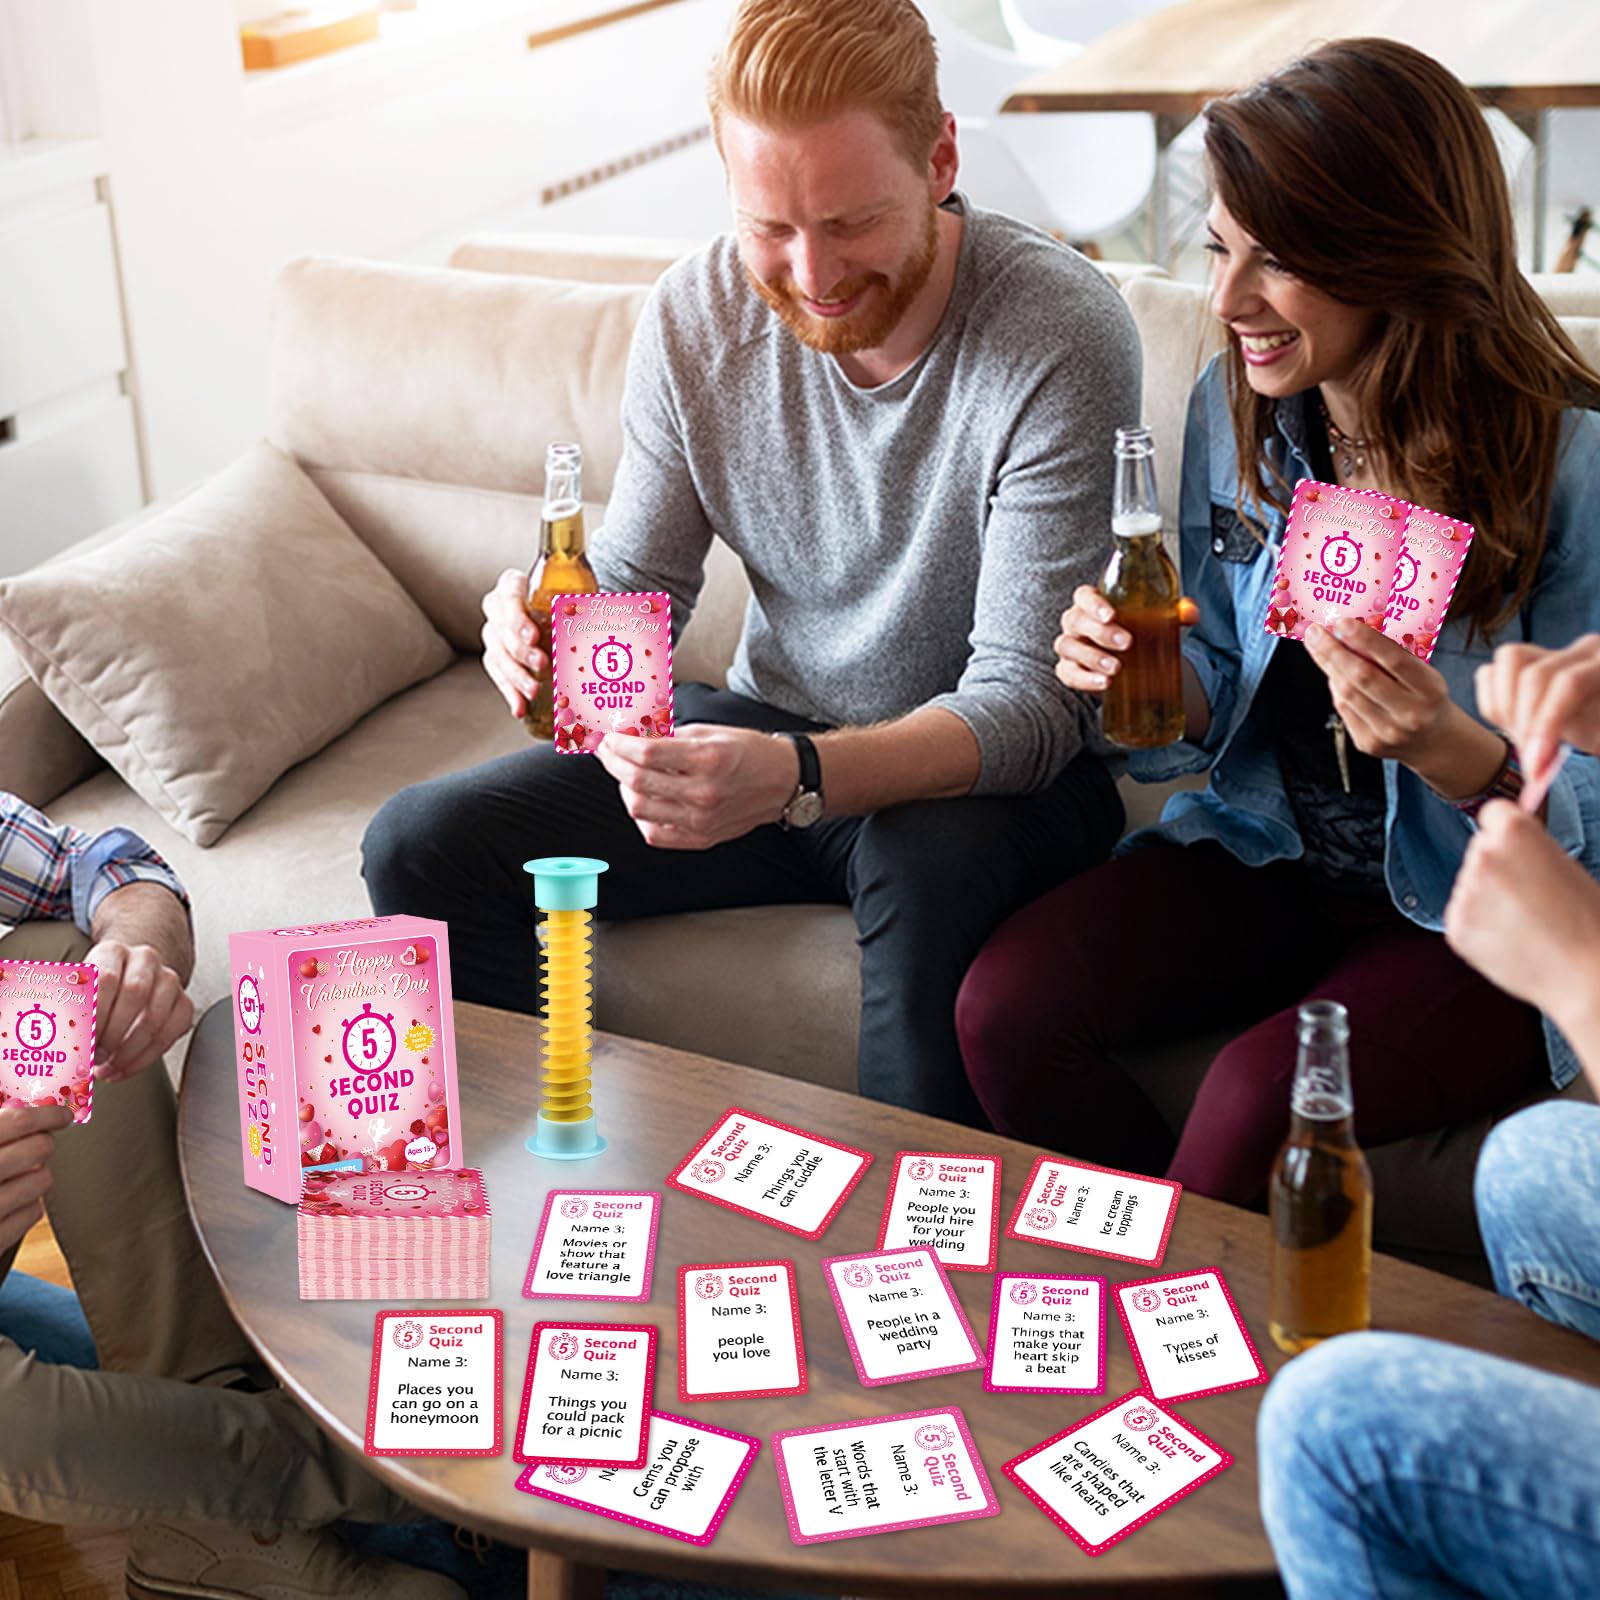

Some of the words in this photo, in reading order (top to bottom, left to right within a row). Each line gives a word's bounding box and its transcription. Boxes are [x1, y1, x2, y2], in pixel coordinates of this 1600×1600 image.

[1330, 492, 1375, 515] Happy
[1367, 519, 1395, 539] Day
[1335, 547, 1347, 567] 5
[1303, 570, 1366, 593] SECOND
[1313, 587, 1352, 605] QUIZ
[589, 600, 634, 616] Happy
[630, 618, 661, 634] Day
[608, 652, 618, 672] 5
[581, 681, 645, 694] SECOND
[594, 696, 632, 710] QUIZ
[334, 950, 395, 976] Happy
[16, 966, 62, 984] Happy
[392, 973, 429, 999] Day
[57, 988, 86, 1005] Day
[31, 1020, 41, 1040] 5
[363, 1028, 377, 1059] 5
[3, 1048, 66, 1063] SECOND
[15, 1064, 53, 1077] QUIZ
[243, 1042, 258, 1120] QUIZ
[330, 1069, 413, 1098] SECOND
[256, 1043, 271, 1166] SECOND
[348, 1093, 399, 1119] QUIZ
[711, 1122, 746, 1158] Second
[408, 1147, 422, 1156] Ages
[724, 1139, 749, 1162] Quiz
[734, 1154, 763, 1183] Name
[758, 1143, 773, 1154] 3:
[939, 1164, 984, 1173] Second
[762, 1168, 795, 1201] Things
[791, 1149, 809, 1168] you
[780, 1189, 798, 1207] can
[794, 1156, 822, 1188] cuddle
[939, 1173, 967, 1182] Quiz
[919, 1187, 955, 1197] Name
[960, 1189, 970, 1198] 3:
[1037, 1170, 1059, 1204] Second
[1051, 1184, 1067, 1207] Quiz
[594, 1202, 642, 1210] Second
[908, 1202, 948, 1213] People
[953, 1206, 975, 1215] you
[1067, 1197, 1086, 1224] Name
[1078, 1186, 1090, 1195] 3:
[1100, 1221, 1114, 1235] Ice
[1111, 1190, 1124, 1219] cream
[592, 1211, 623, 1219] Quiz
[907, 1215, 945, 1224] would
[950, 1216, 974, 1226] hire
[1116, 1195, 1138, 1236] toppings
[572, 1225, 609, 1233] Name
[614, 1225, 625, 1234] 3:
[913, 1225, 931, 1235] for
[935, 1228, 965, 1238] your
[563, 1239, 608, 1248] Movies
[909, 1238, 965, 1251] wedding
[560, 1249, 595, 1258] show
[599, 1249, 625, 1259] that
[561, 1259, 608, 1270] feature
[875, 1259, 923, 1272] Second
[546, 1270, 573, 1280] love
[578, 1272, 631, 1284] triangle
[729, 1274, 777, 1284] Second
[880, 1272, 911, 1284] Quiz
[730, 1287, 760, 1297] Quiz
[868, 1290, 908, 1303] Name
[910, 1287, 923, 1297] 3:
[1043, 1286, 1088, 1295] Second
[1163, 1281, 1209, 1296] Second
[1042, 1296, 1071, 1306] Quiz
[1167, 1294, 1198, 1307] Quiz
[712, 1306, 751, 1316] Name
[755, 1304, 767, 1314] 3:
[1024, 1312, 1060, 1321] Name
[1065, 1313, 1075, 1322] 3:
[1156, 1311, 1194, 1326] Name
[1197, 1309, 1209, 1318] 3:
[867, 1315, 912, 1330] People
[915, 1312, 928, 1322] in
[932, 1312, 940, 1320] a
[404, 1331, 412, 1342] 5
[429, 1324, 482, 1334] Second
[879, 1325, 938, 1341] wedding
[1012, 1327, 1054, 1339] Things
[1060, 1330, 1085, 1339] that
[429, 1336, 463, 1348] Quiz
[559, 1343, 568, 1353] 5
[584, 1338, 636, 1349] Second
[718, 1333, 764, 1348] people
[897, 1339, 931, 1354] party
[1014, 1340, 1048, 1349] make
[1052, 1342, 1081, 1351] your
[1163, 1339, 1202, 1354] Types
[1206, 1333, 1219, 1345] of
[408, 1357, 450, 1367] Name
[455, 1357, 467, 1367] 3:
[584, 1351, 616, 1361] Quiz
[713, 1351, 738, 1362] you
[743, 1348, 770, 1358] love
[1014, 1351, 1048, 1360] heart
[1052, 1352, 1079, 1363] skip
[1176, 1349, 1216, 1364] kisses
[560, 1369, 602, 1380] Name
[606, 1370, 619, 1381] 3:
[1038, 1363, 1066, 1373] beat
[398, 1383, 442, 1395] Places
[447, 1386, 473, 1396] you
[392, 1401, 417, 1409] can
[422, 1401, 441, 1411] go
[549, 1396, 596, 1410] Things
[601, 1399, 627, 1411] you
[391, 1412, 478, 1425] honeymoon
[547, 1410, 586, 1422] could
[591, 1411, 625, 1425] pack
[542, 1423, 563, 1435] for
[567, 1427, 575, 1436] a
[580, 1426, 623, 1439] picnic
[1148, 1434, 1177, 1459] Quiz
[1158, 1426, 1206, 1463] Second
[814, 1446, 827, 1466] the
[1112, 1433, 1147, 1464] Name
[1146, 1461, 1161, 1475] 3:
[634, 1462, 662, 1497] Gems
[658, 1439, 678, 1462] you
[833, 1449, 852, 1477] start
[891, 1445, 911, 1481] Name
[904, 1484, 919, 1496] 3:
[650, 1488, 669, 1510] can
[665, 1438, 699, 1487] propose
[682, 1465, 704, 1492] with
[851, 1440, 872, 1480] Words
[862, 1483, 880, 1509] that
[924, 1456, 944, 1486] Quiz
[942, 1453, 972, 1501] Second
[1074, 1440, 1119, 1481] Candies
[1119, 1479, 1145, 1504] that
[819, 1470, 837, 1502] letter
[1063, 1453, 1083, 1471] are
[1082, 1469, 1128, 1509] shaped
[842, 1479, 861, 1507] with
[1049, 1462, 1073, 1483] like
[1071, 1481, 1109, 1517] hearts
[829, 1505, 843, 1514] V
